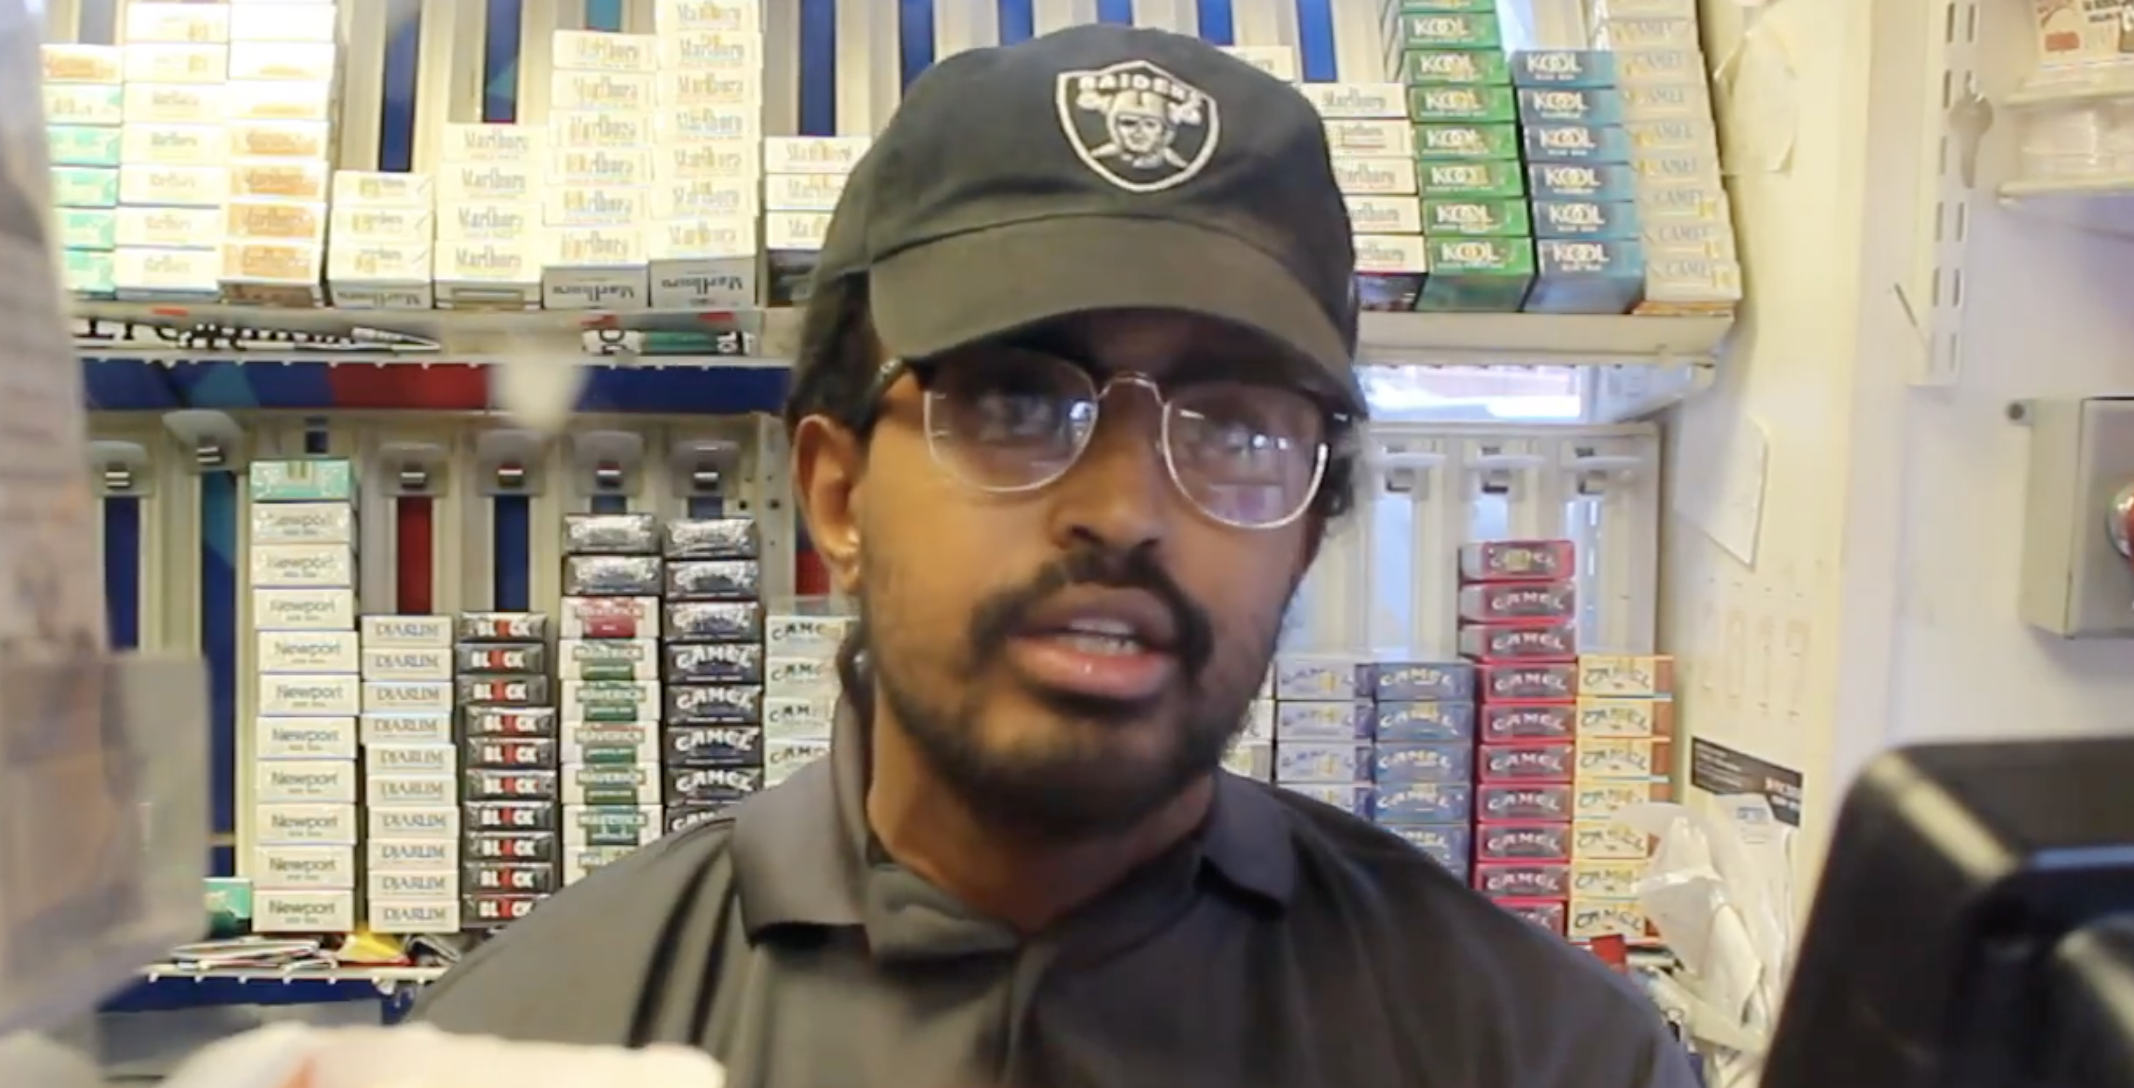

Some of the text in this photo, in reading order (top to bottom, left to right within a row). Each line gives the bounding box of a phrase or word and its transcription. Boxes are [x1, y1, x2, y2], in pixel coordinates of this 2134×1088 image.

[1413, 17, 1471, 37] KOOL
[1526, 53, 1582, 73] KOOL
[1533, 91, 1589, 111] KOOL
[464, 129, 529, 151] Marlboro
[1539, 128, 1597, 149] KOOL
[461, 167, 526, 190] Marlboro
[1431, 166, 1489, 186] KOO
[1545, 166, 1602, 187] KOOL
[458, 206, 524, 229] Marlboro
[1549, 204, 1606, 225] KOOL
[455, 245, 521, 268] Marlboro
[1442, 242, 1500, 262] KOOL
[1553, 243, 1611, 263] KOOL
[1490, 550, 1556, 568] CEL
[1491, 591, 1565, 610] CAMEL
[275, 641, 341, 659] Newport
[1491, 632, 1566, 651] CAMEL
[676, 645, 753, 669] CAMEL
[1494, 672, 1567, 691] CAMEL
[276, 683, 343, 701] Newport
[677, 687, 754, 710] CAMEL
[1379, 703, 1454, 727] CAL
[1492, 713, 1566, 732] CAMEL
[272, 727, 339, 746] Newport
[675, 729, 754, 752] CAMEL
[1490, 753, 1564, 772] CAMEL
[271, 771, 338, 788] Newport
[676, 769, 753, 792] CAMEL
[1488, 792, 1561, 812] CAMEL
[271, 814, 338, 831] Newport
[1487, 832, 1560, 851] CAMEL
[269, 857, 336, 874] Newport
[1487, 872, 1560, 891] CAMEL
[268, 899, 335, 917] Newport
